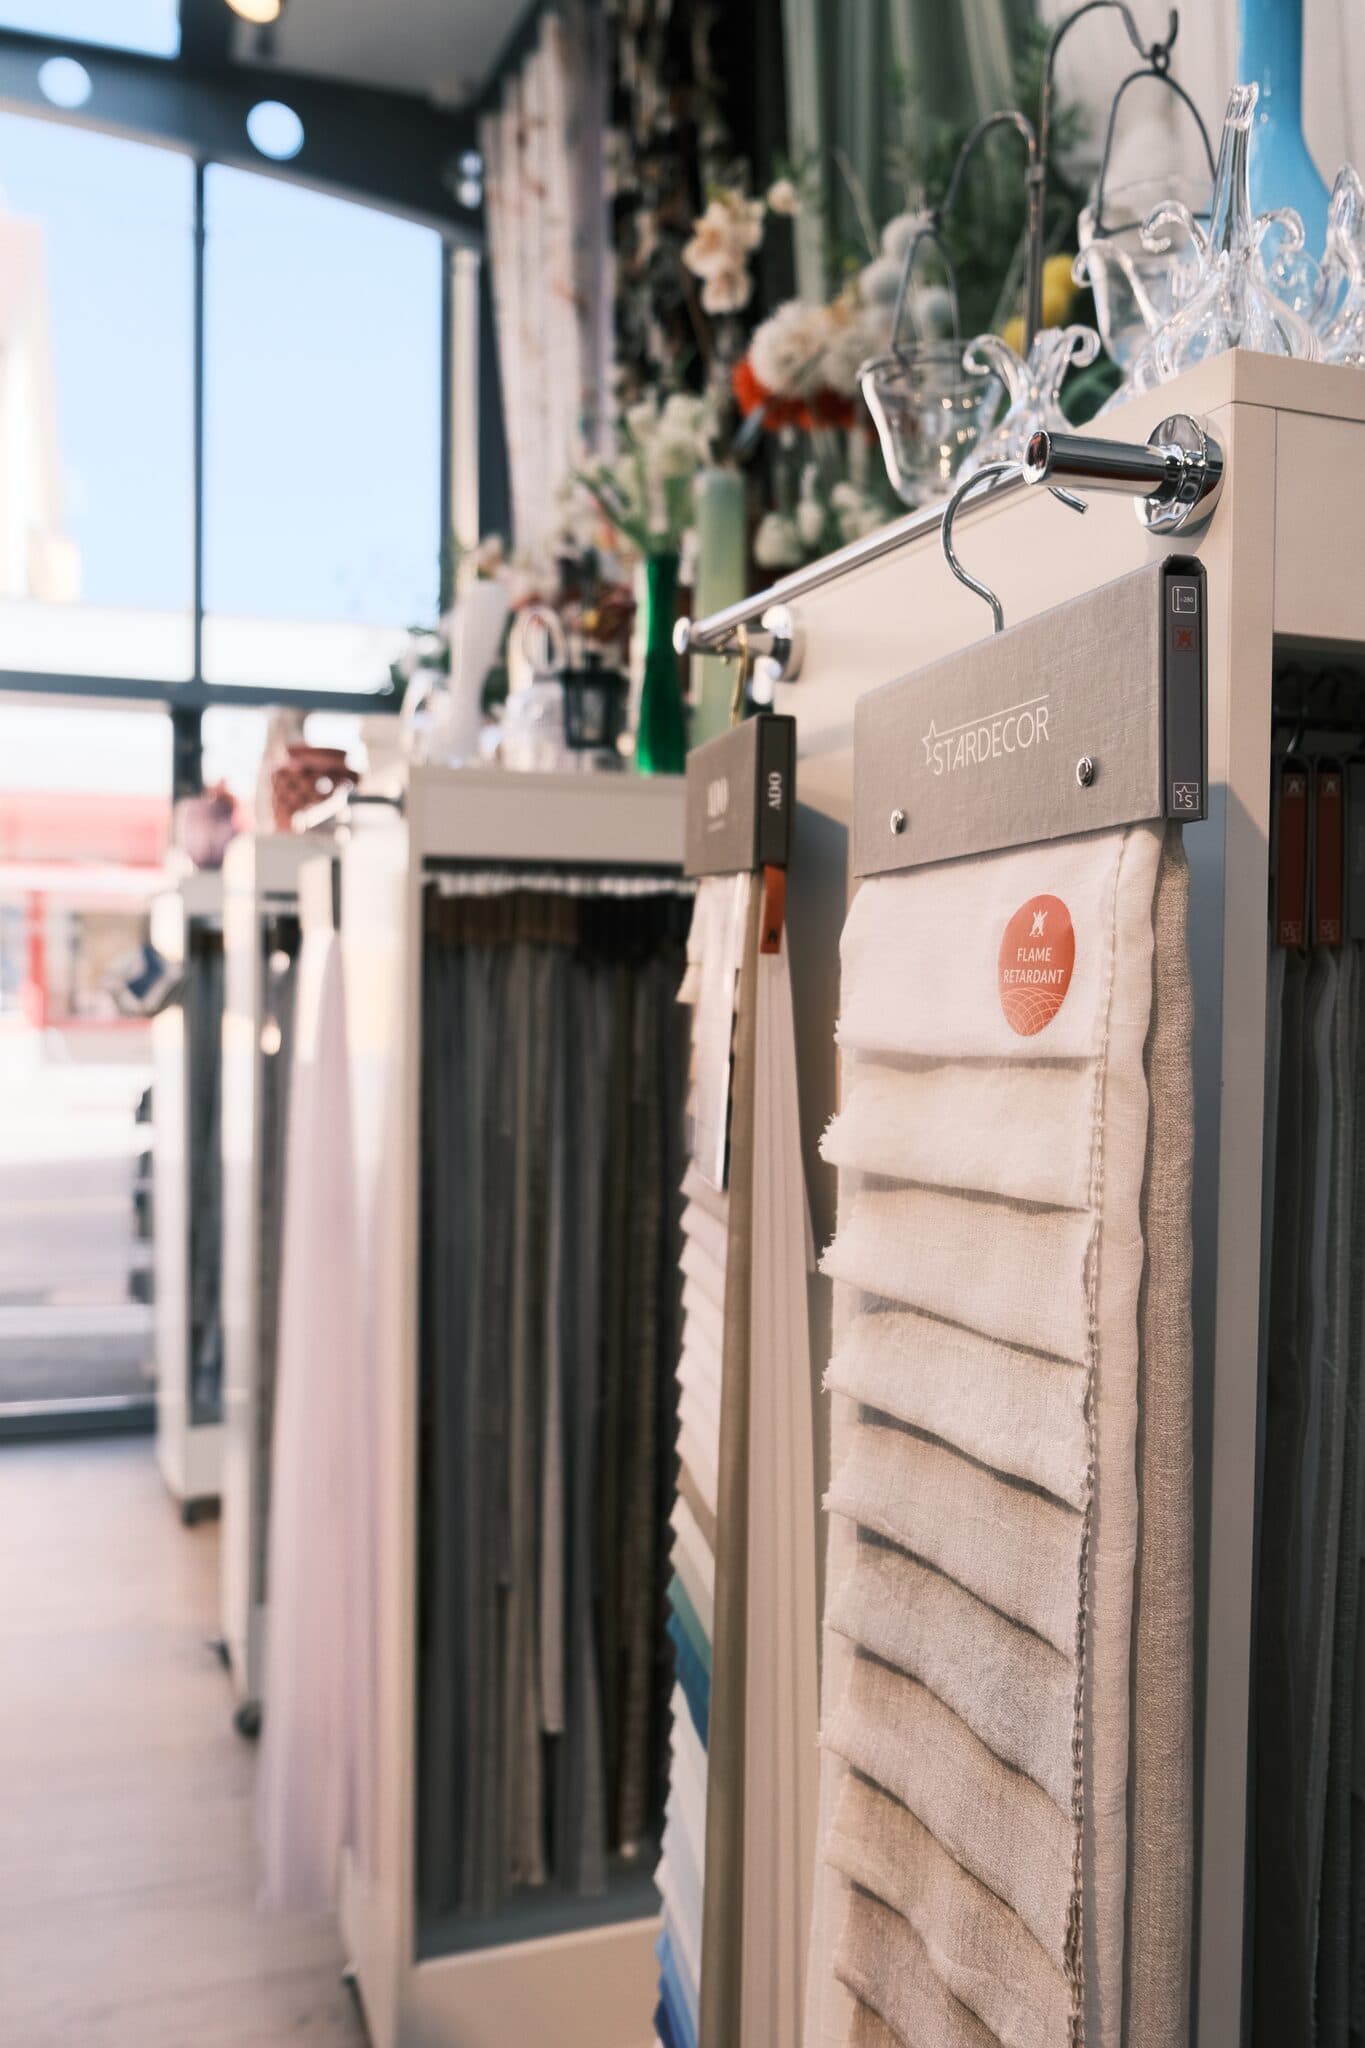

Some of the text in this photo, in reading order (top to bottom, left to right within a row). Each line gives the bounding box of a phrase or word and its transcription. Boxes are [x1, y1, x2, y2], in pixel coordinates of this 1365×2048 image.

[932, 706, 1050, 776] STARDECOR
[768, 772, 782, 810] ADO
[1017, 947, 1053, 962] FLAME
[1003, 969, 1064, 985] RETARDANT
